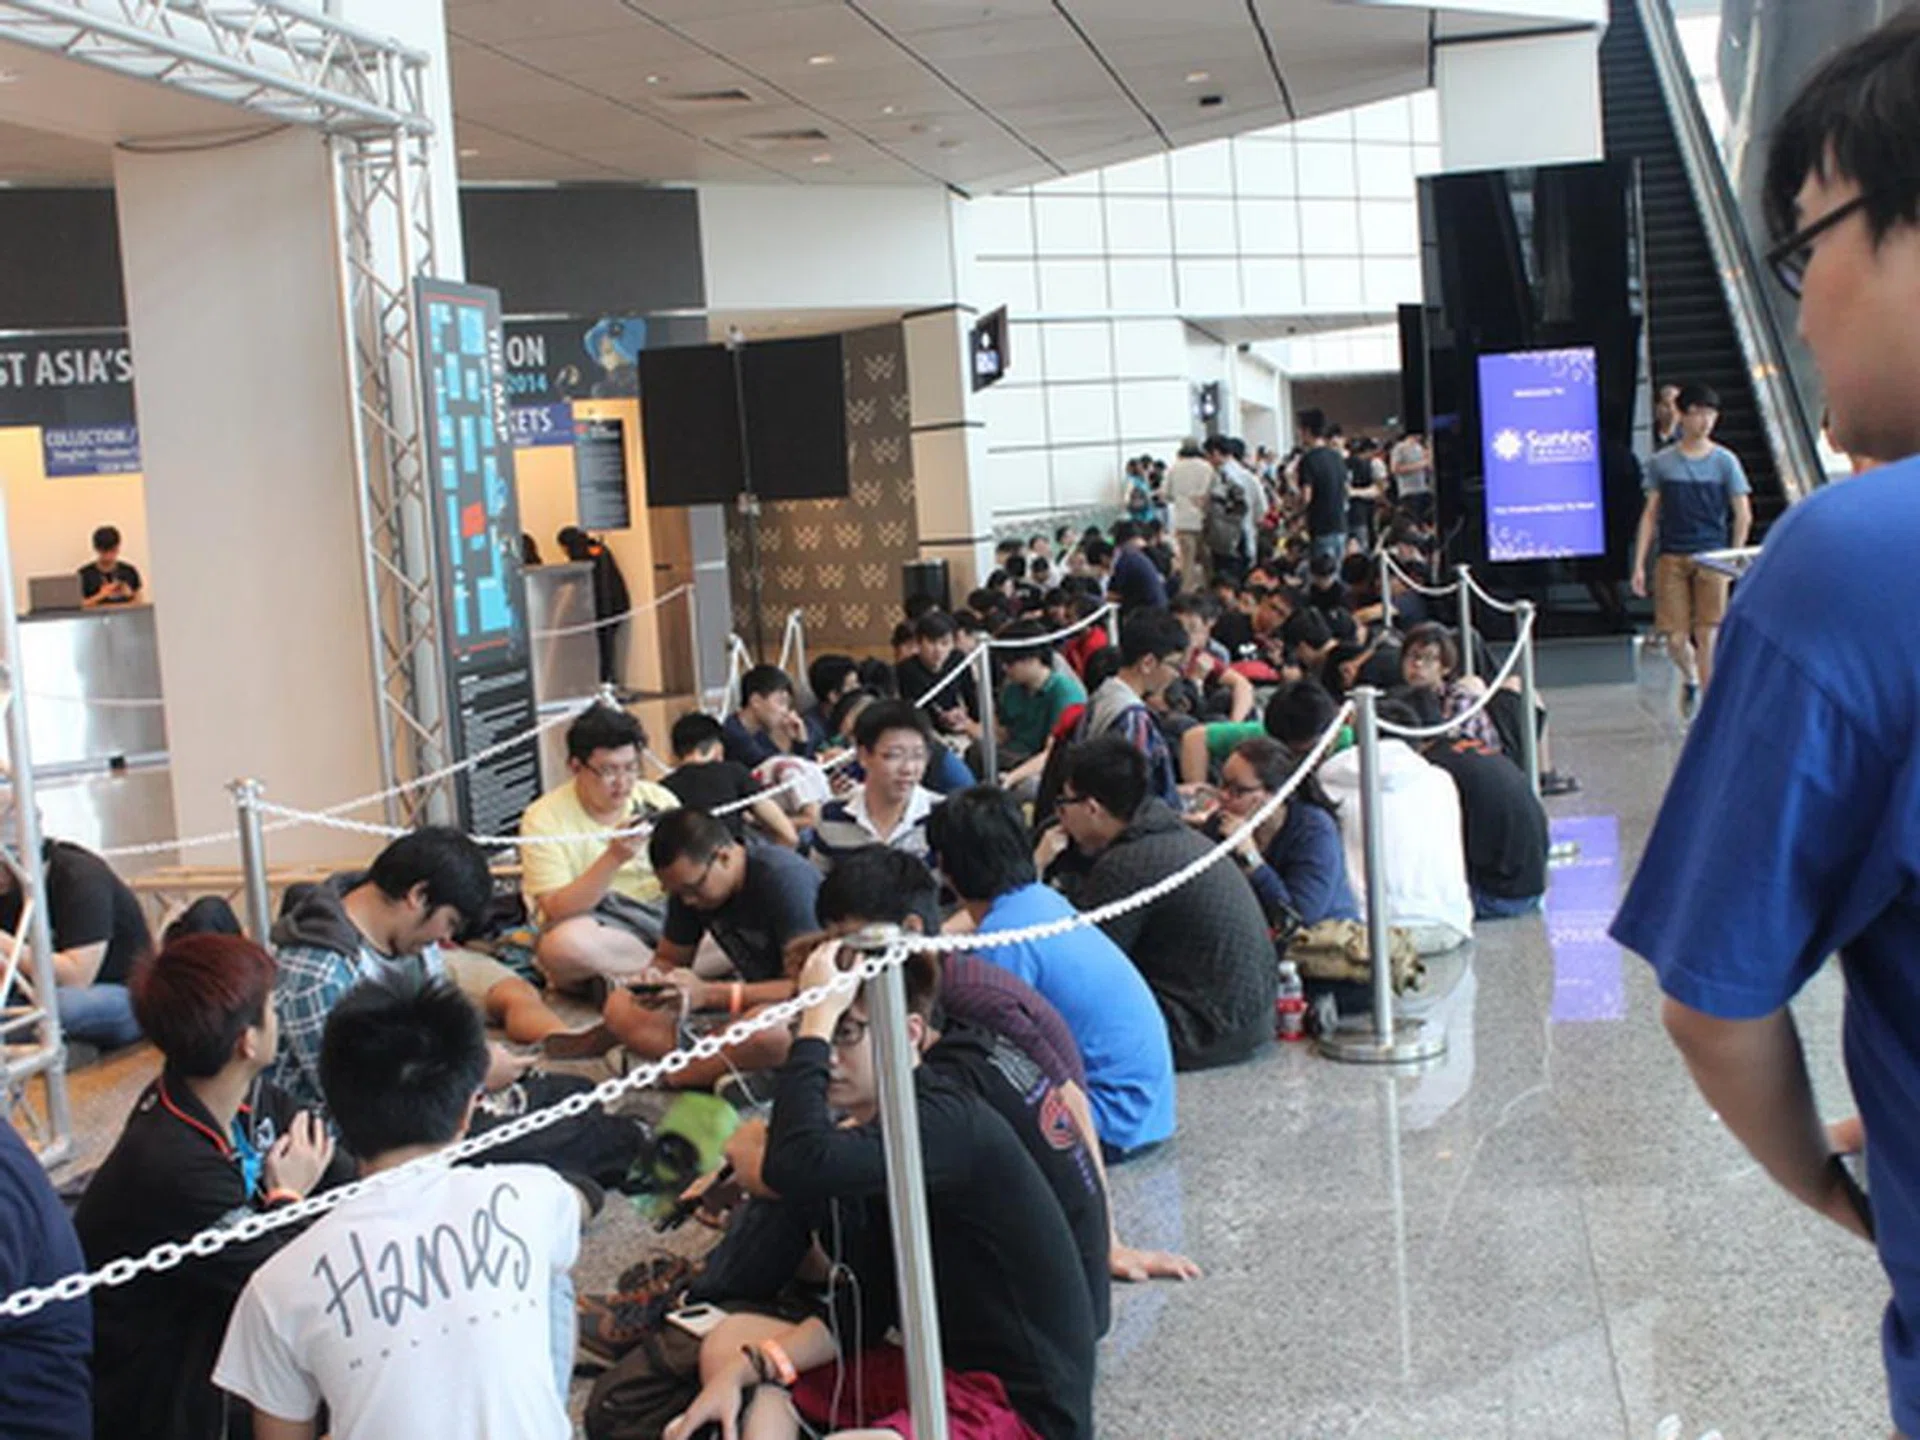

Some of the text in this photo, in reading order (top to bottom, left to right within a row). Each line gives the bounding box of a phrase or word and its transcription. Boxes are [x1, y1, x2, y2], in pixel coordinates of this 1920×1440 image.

[36, 349, 134, 385] ASIA'S
[506, 335, 546, 367] ON
[506, 373, 547, 393] 2014
